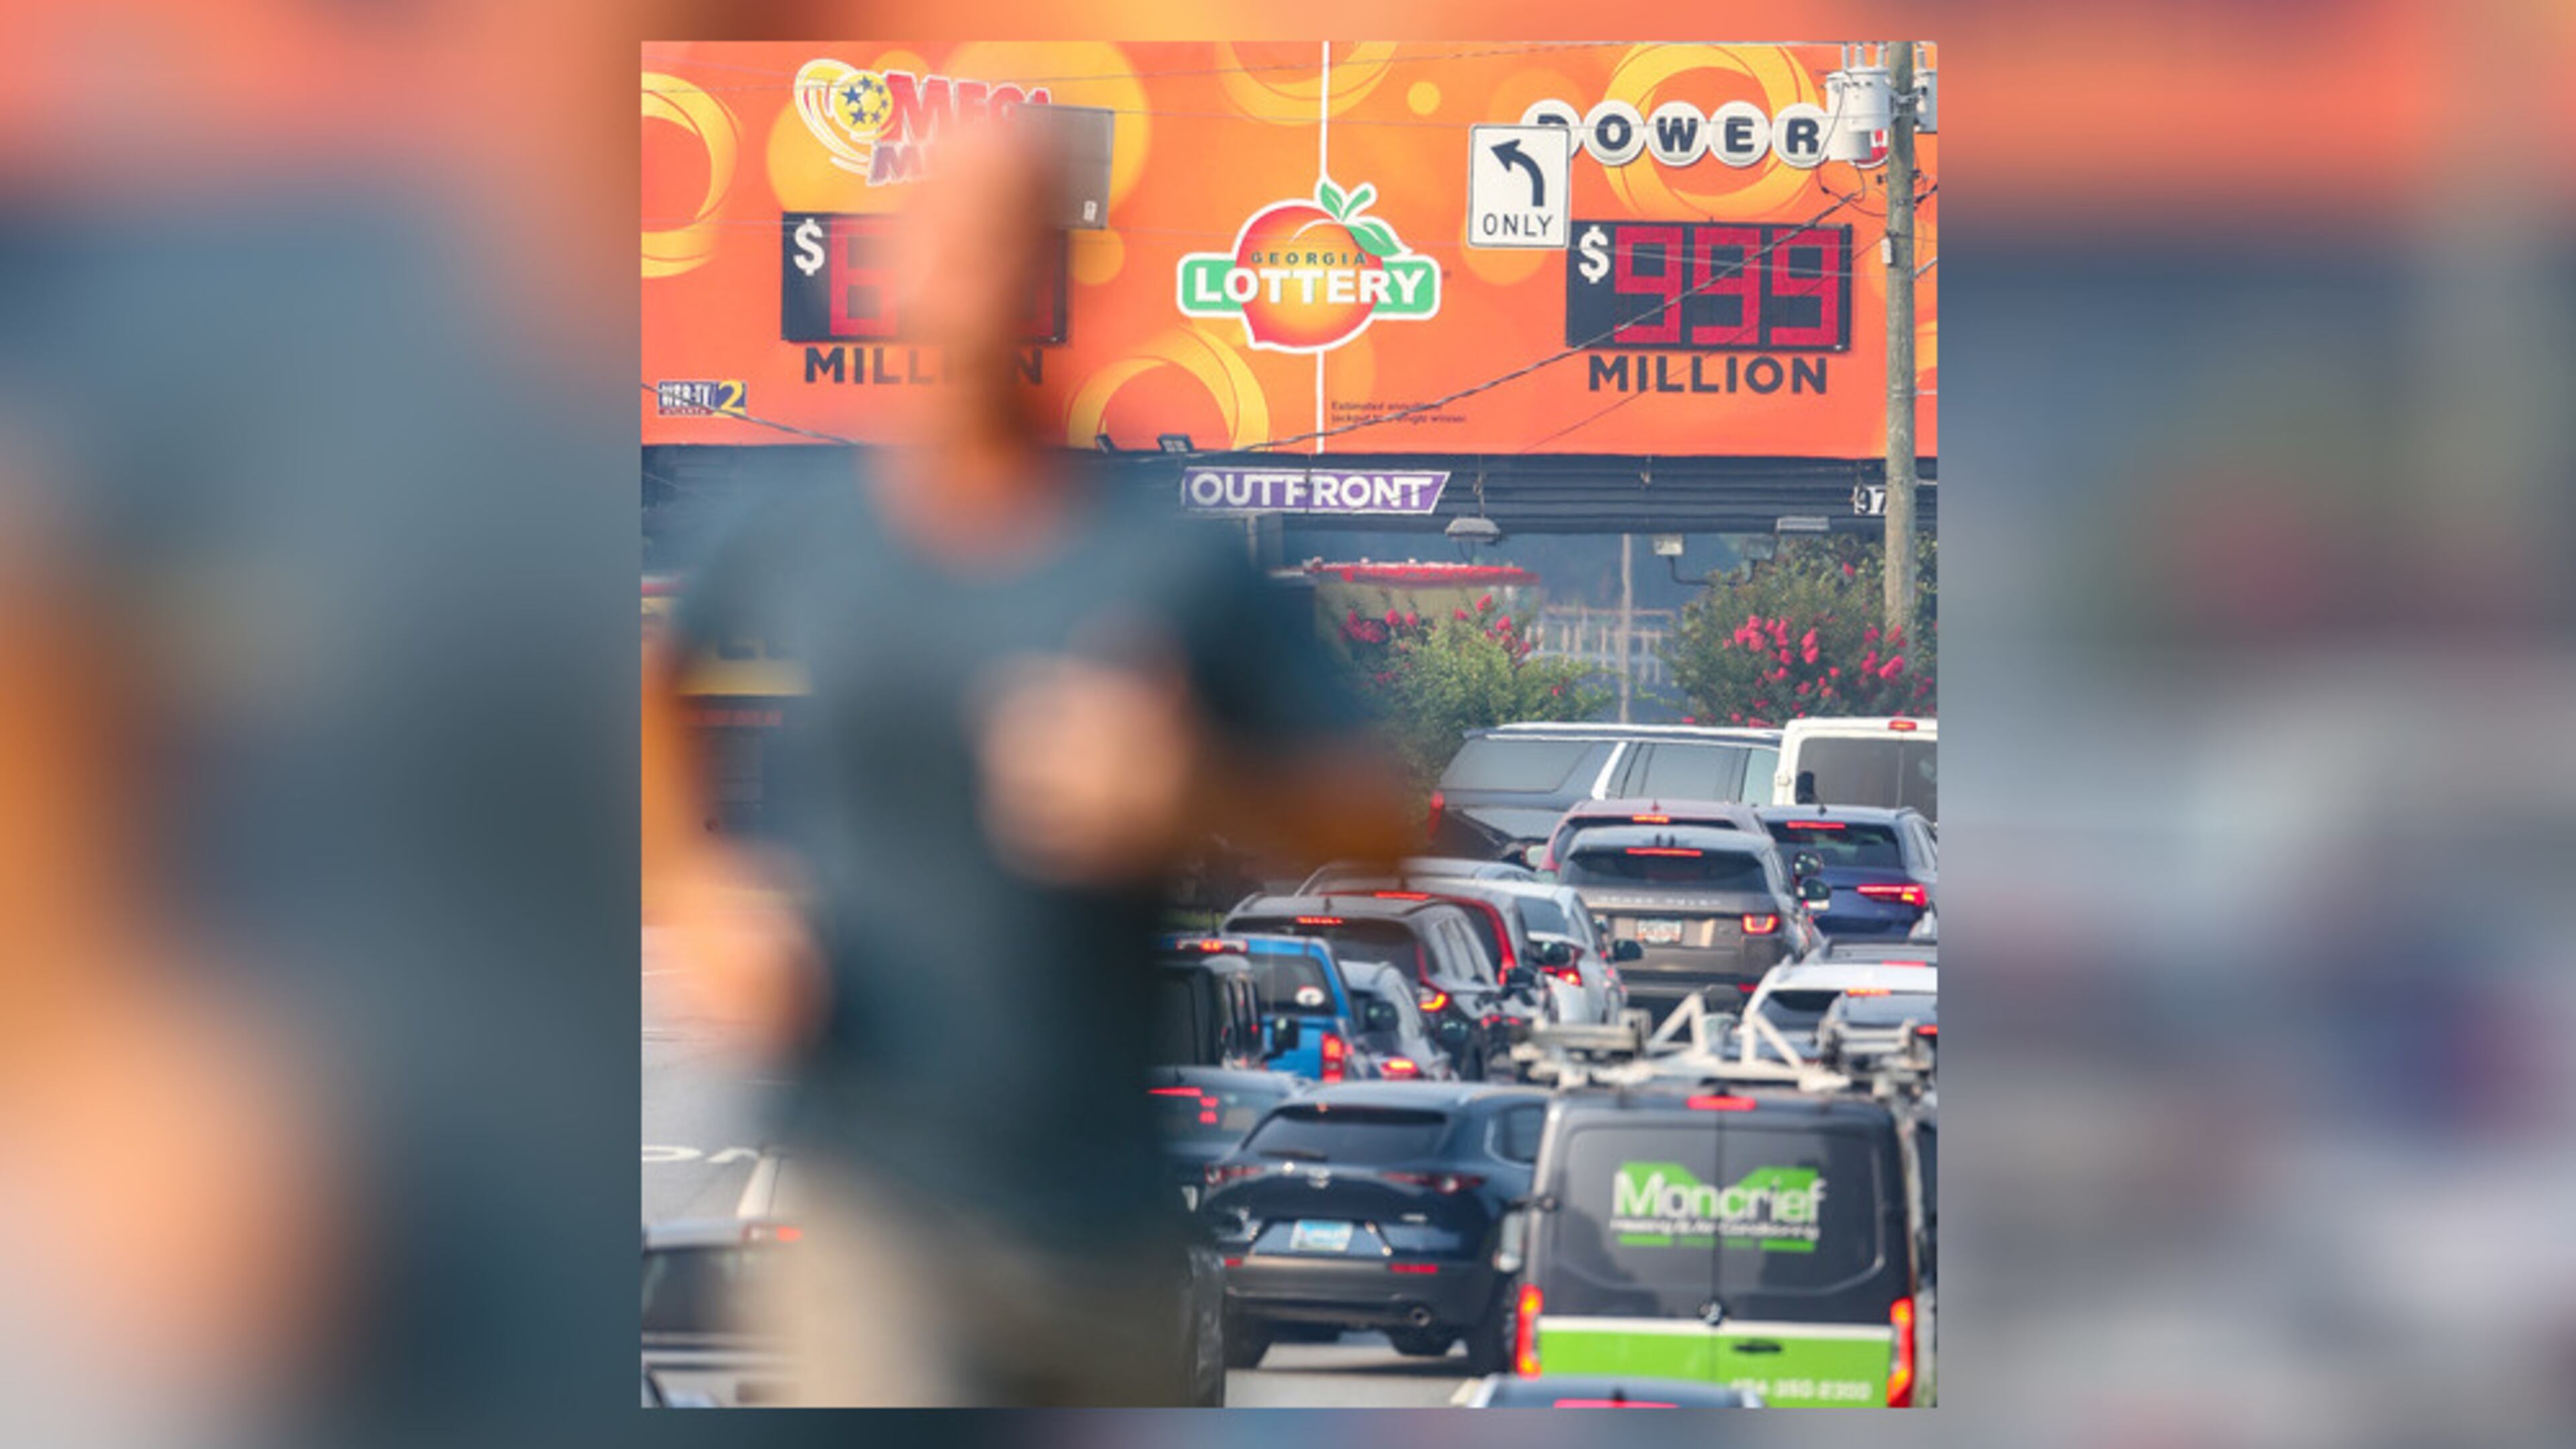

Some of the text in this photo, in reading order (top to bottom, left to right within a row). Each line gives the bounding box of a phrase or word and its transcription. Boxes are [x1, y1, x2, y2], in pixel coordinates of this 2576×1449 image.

[1482, 212, 1554, 237] ONLY
[1250, 252, 1366, 266] GEORGIA
[1194, 266, 1426, 305] LOTTERY
[804, 347, 1044, 384] MILLN
[1589, 355, 1827, 394] MILLION
[1190, 472, 1434, 507] OUTFRONT
[1612, 1171, 1827, 1224] Moncrief
